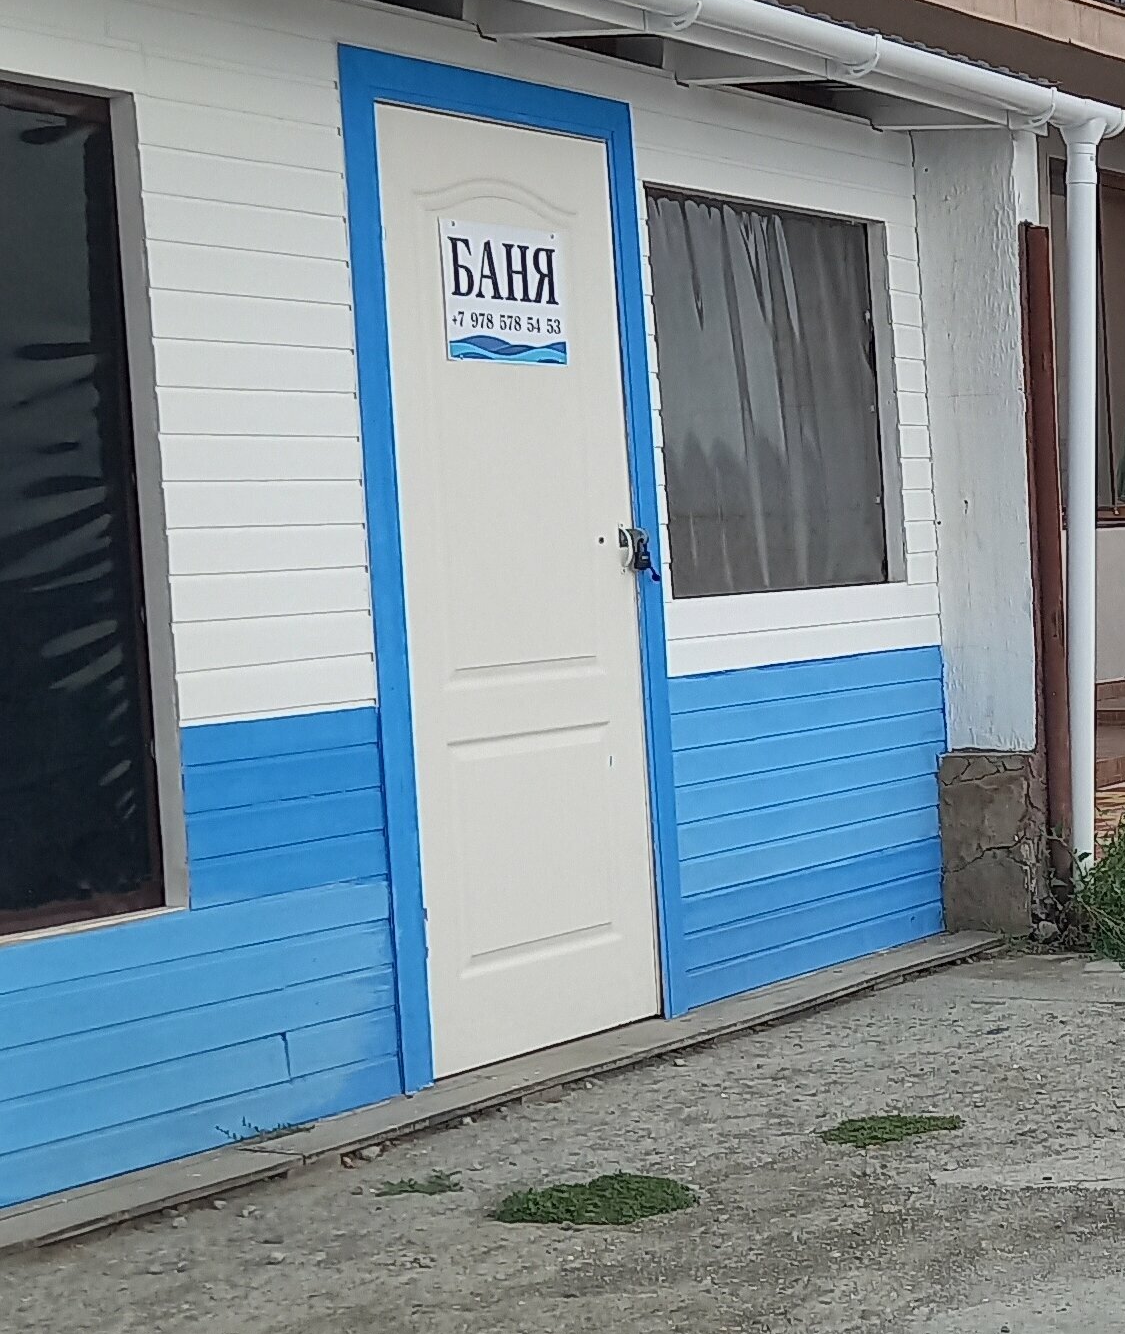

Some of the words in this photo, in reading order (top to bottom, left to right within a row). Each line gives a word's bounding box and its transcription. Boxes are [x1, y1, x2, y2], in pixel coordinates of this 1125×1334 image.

[447, 235, 560, 305] БАНЯ
[451, 310, 465, 327] +7
[470, 312, 495, 330] 978
[499, 314, 522, 332] 578
[526, 316, 541, 334] 54
[546, 318, 562, 335] 53
